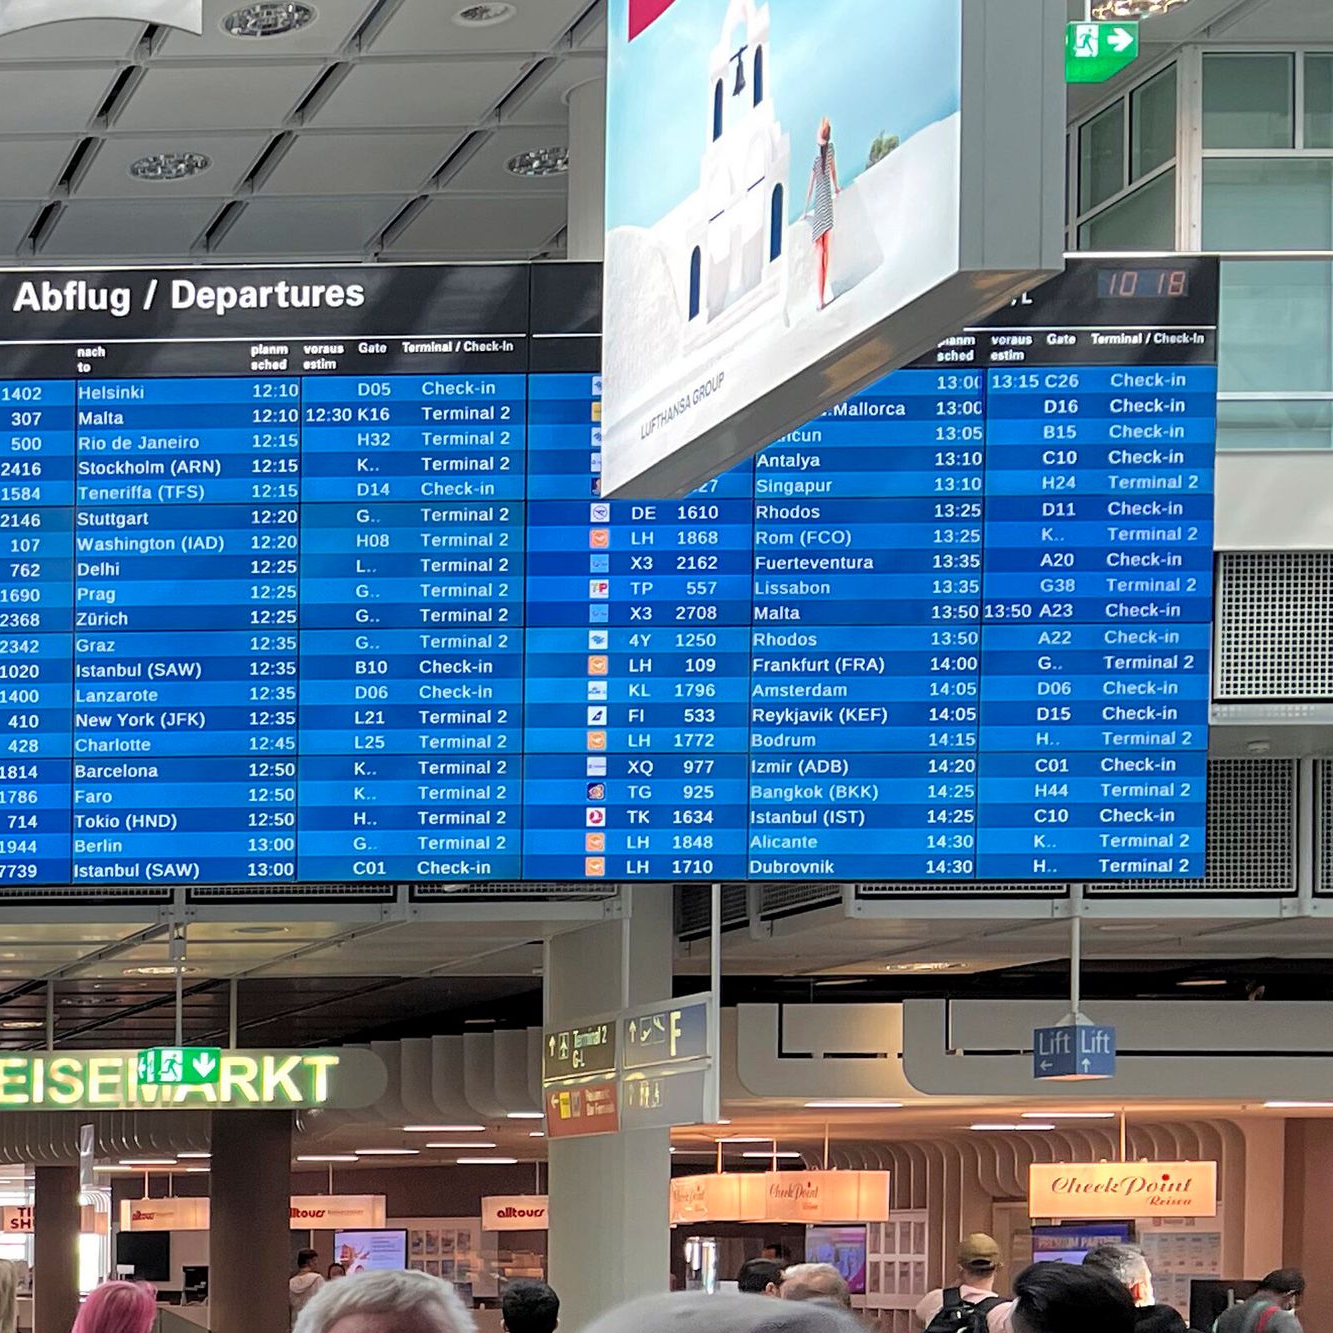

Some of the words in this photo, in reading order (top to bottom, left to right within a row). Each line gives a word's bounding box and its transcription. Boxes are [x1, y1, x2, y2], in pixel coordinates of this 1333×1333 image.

[12, 279, 131, 317] Abflug
[143, 278, 158, 310] /
[171, 279, 365, 316] Departures
[1090, 332, 1143, 345] Terminal
[1144, 332, 1152, 345] /
[11, 411, 42, 427] 307
[78, 410, 124, 426] Malta
[252, 408, 299, 423] 12:10
[306, 407, 353, 422] 12:30
[357, 407, 390, 422] K16
[421, 405, 495, 421] Terminal
[500, 405, 511, 420] 2
[640, 394, 691, 440] LUFTHANSA
[692, 371, 724, 405] GROUP
[630, 556, 653, 570] X3
[676, 555, 718, 570] 2162
[755, 556, 874, 570] Fuerteventura
[932, 553, 981, 569] 13:35
[1039, 552, 1074, 567] A20
[1106, 551, 1182, 567] Check-in
[7, 714, 40, 729] 410
[75, 713, 113, 727] New
[117, 712, 155, 727] York
[160, 711, 206, 730] (JFK)
[249, 711, 296, 726] 12:35
[354, 710, 385, 725] L21
[418, 709, 492, 724] Terminal
[497, 709, 508, 724] 2
[627, 785, 652, 799] TG
[683, 785, 714, 799] 925
[750, 784, 823, 802] Bangkok
[829, 784, 879, 802] (BKK)
[928, 784, 975, 798] 14:25
[1034, 783, 1069, 798] H44
[1100, 782, 1175, 797] Terminal
[1180, 782, 1191, 797] 2
[669, 1010, 682, 1057] F
[1038, 1030, 1072, 1056] Lift
[1081, 1029, 1111, 1055] Lift
[496, 1206, 546, 1218] alltours
